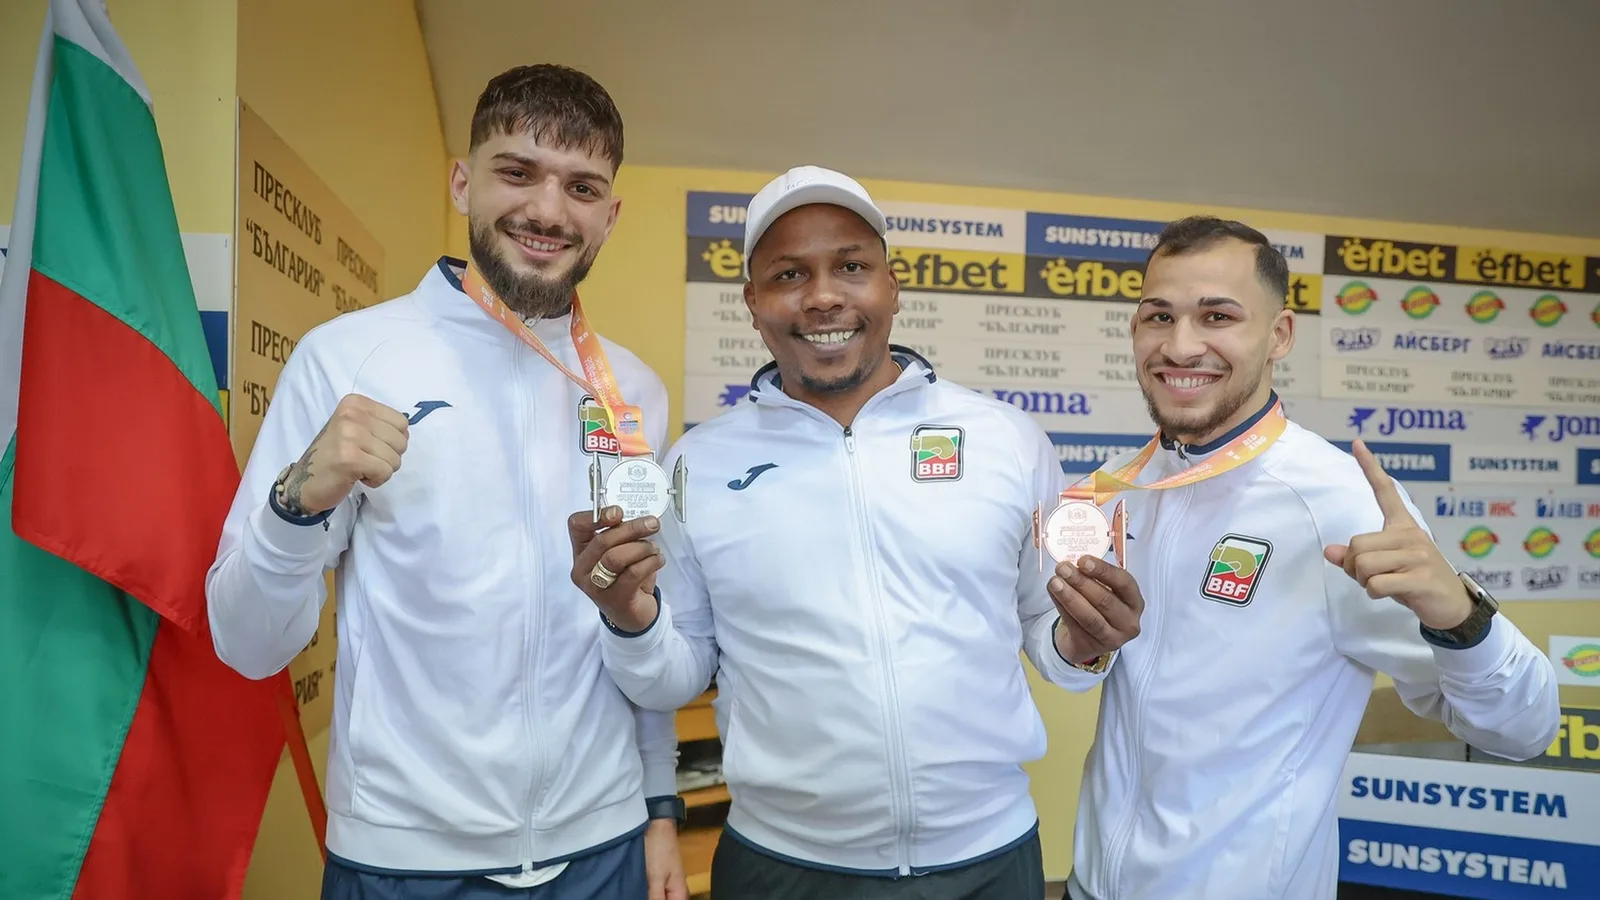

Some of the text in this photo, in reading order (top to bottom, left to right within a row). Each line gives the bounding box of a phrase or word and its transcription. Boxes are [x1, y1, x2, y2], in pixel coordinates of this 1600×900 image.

[253, 160, 322, 245] ПРЕСКЛУБ
[708, 204, 747, 225] SUN
[887, 216, 1003, 238] SUNSYSTEM
[1045, 225, 1159, 249] SUNSYSTEM
[889, 252, 1008, 289] efbet
[1344, 240, 1447, 278] efbet
[1477, 253, 1572, 286] efbet
[1048, 261, 1142, 299] efbe
[1393, 333, 1472, 353] АЙСБЕРГ
[1541, 342, 1600, 360] АЙСБЕ
[1379, 407, 1467, 436] Joma
[587, 434, 618, 450] BBF
[919, 462, 957, 476] BBF
[1469, 456, 1560, 472] SUNSYSTEM
[1207, 577, 1249, 598] BBF
[1351, 775, 1568, 818] SUNSYSTEM
[1346, 838, 1568, 889] SUNSYSTEM
